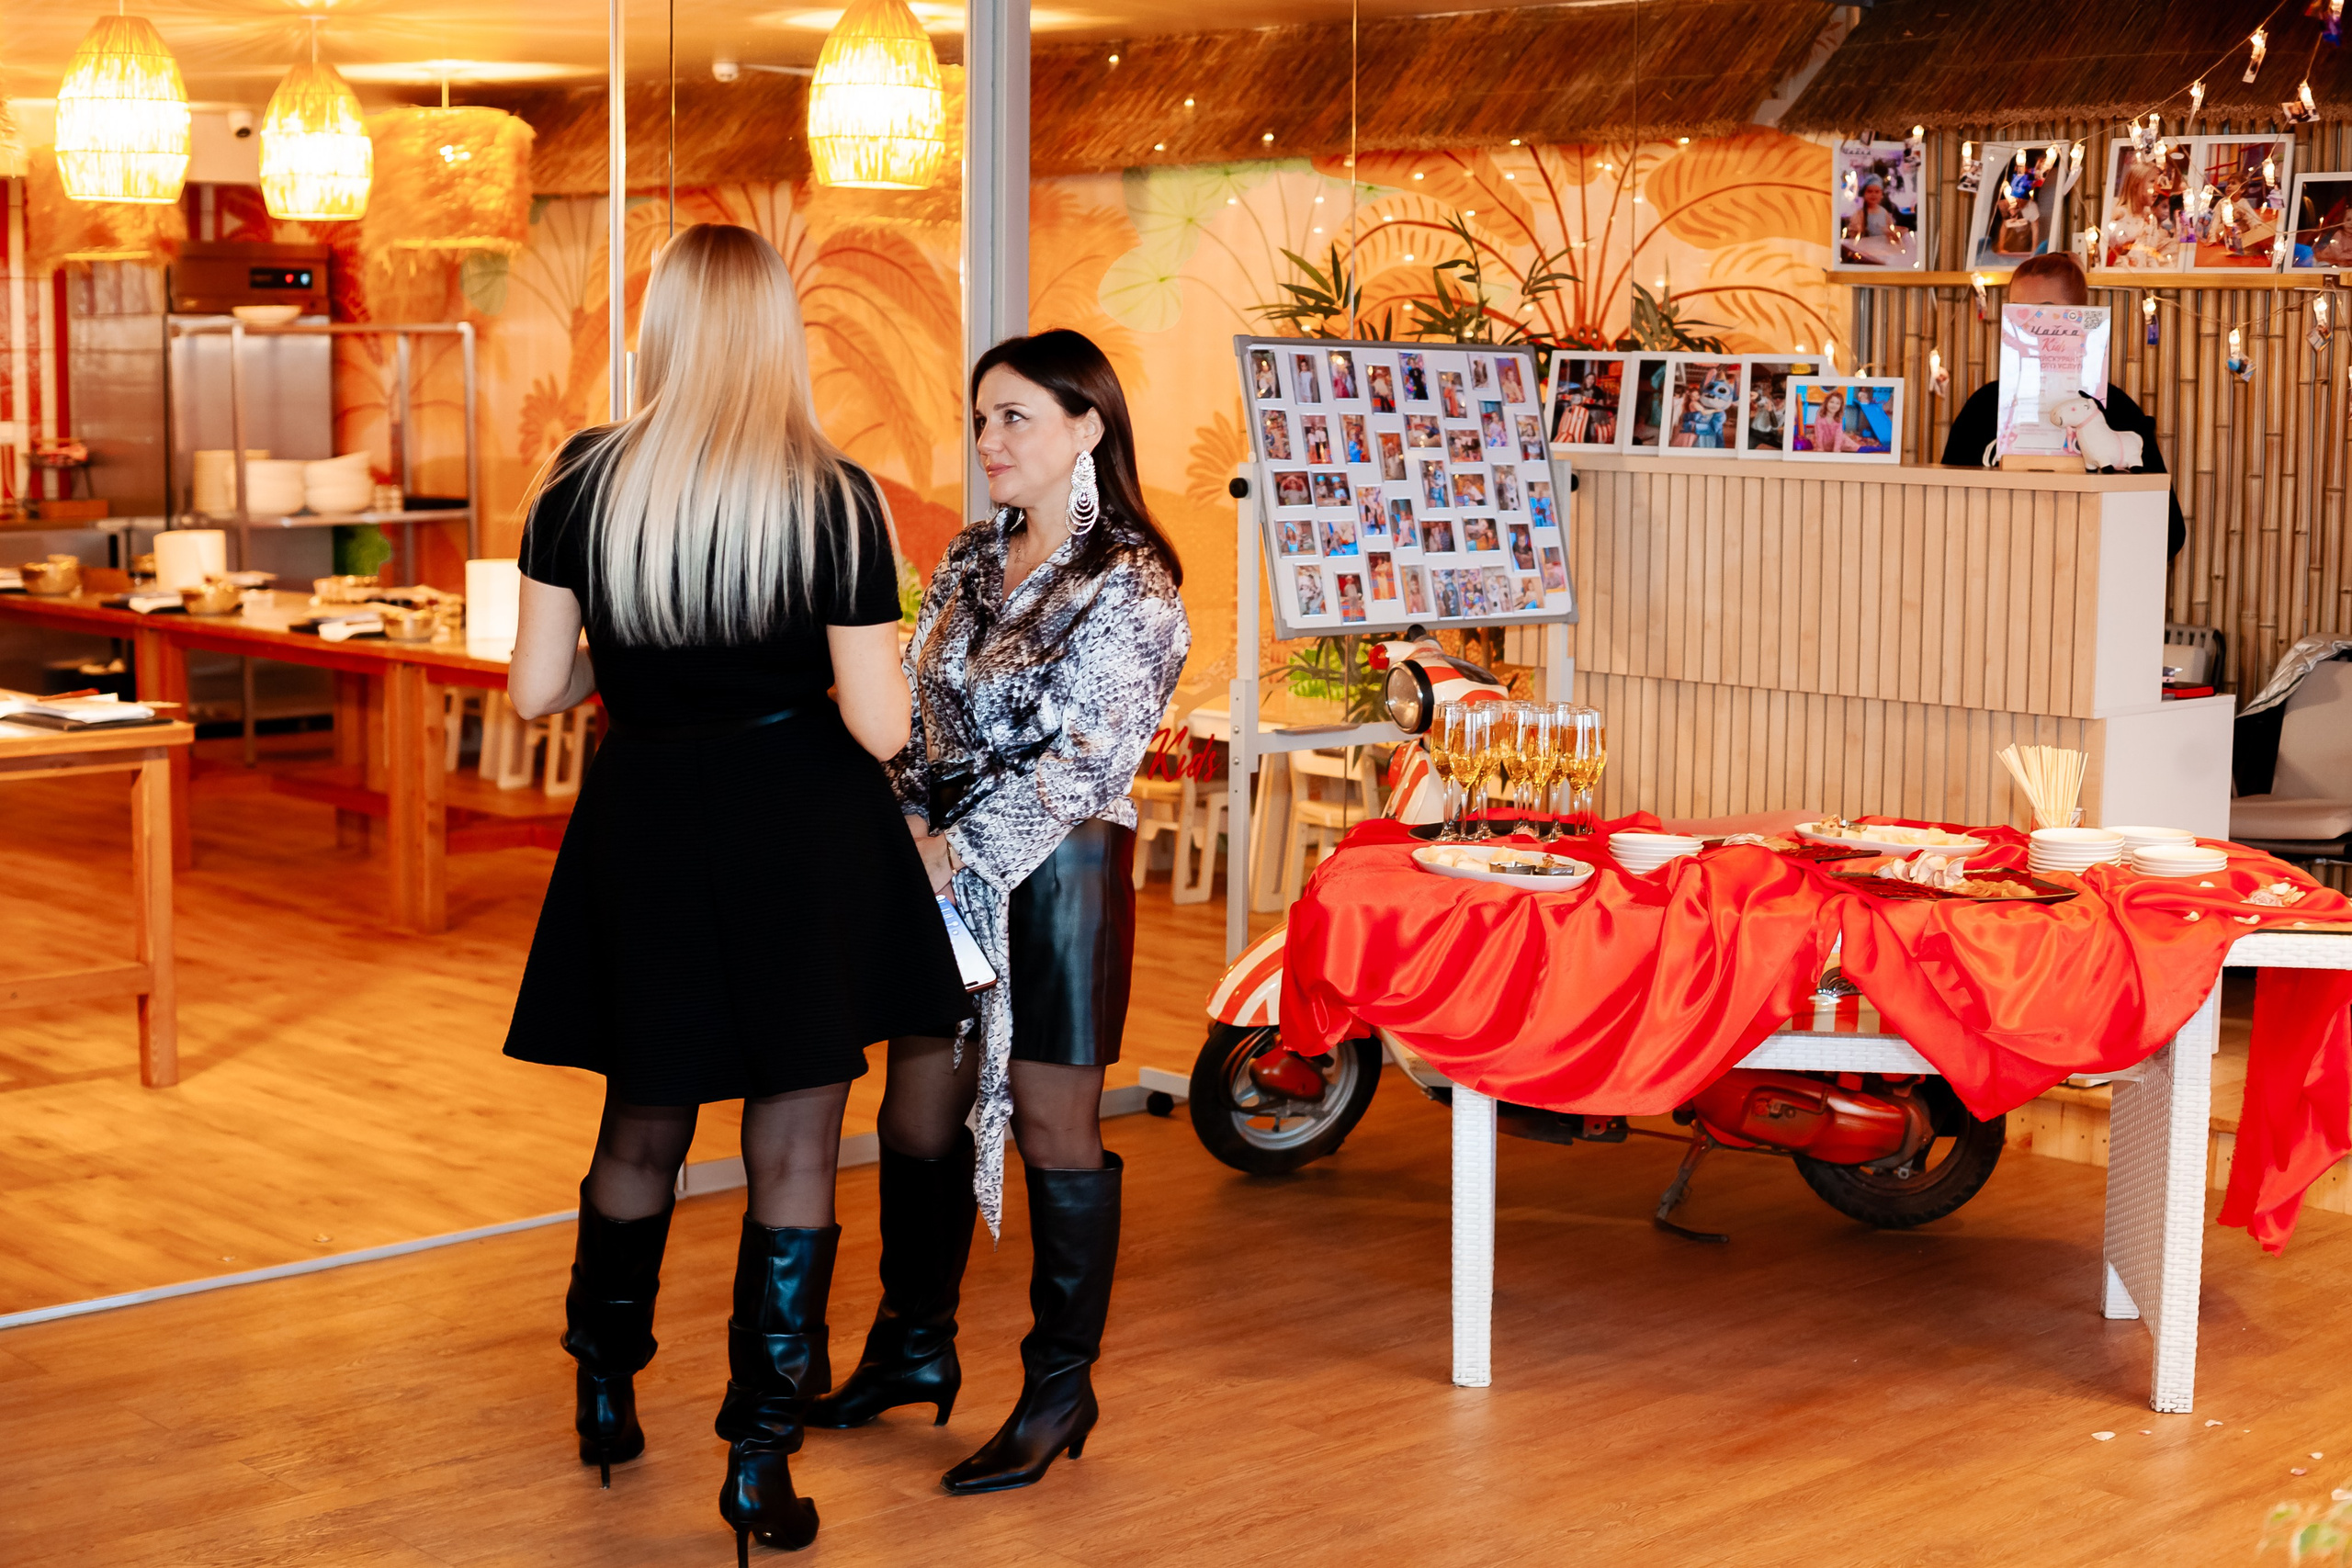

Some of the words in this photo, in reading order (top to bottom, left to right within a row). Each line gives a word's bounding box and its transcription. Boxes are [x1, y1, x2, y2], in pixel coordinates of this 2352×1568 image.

[2030, 325, 2079, 336] Чайка
[2041, 337, 2065, 352] Kids
[1147, 726, 1220, 784] Kids
